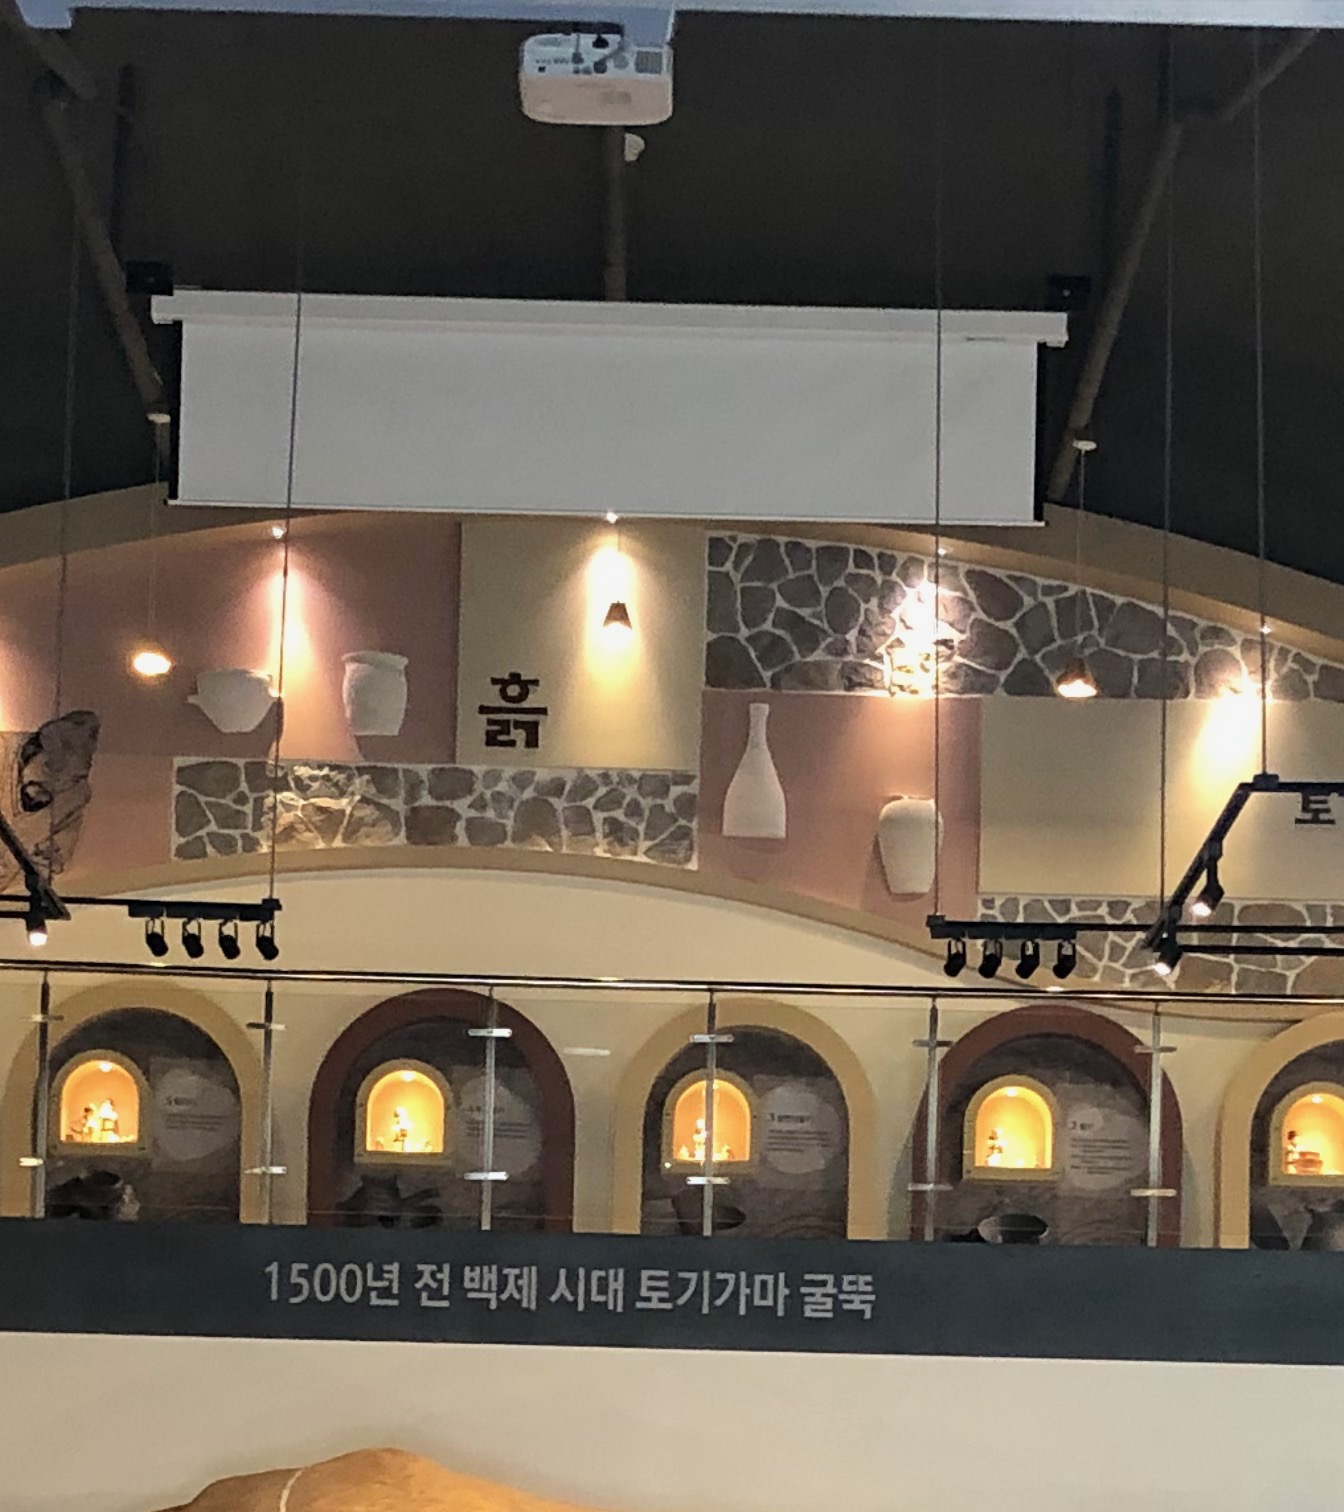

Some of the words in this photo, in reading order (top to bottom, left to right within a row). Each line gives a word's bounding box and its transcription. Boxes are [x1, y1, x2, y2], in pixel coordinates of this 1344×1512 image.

[477, 671, 548, 749] 흙
[262, 1261, 400, 1308] 1500년
[414, 1263, 452, 1309] 전
[462, 1264, 538, 1312] 백제
[549, 1267, 625, 1313] 시대
[634, 1269, 789, 1318] 토기가마
[799, 1272, 877, 1321] 굴뚝
